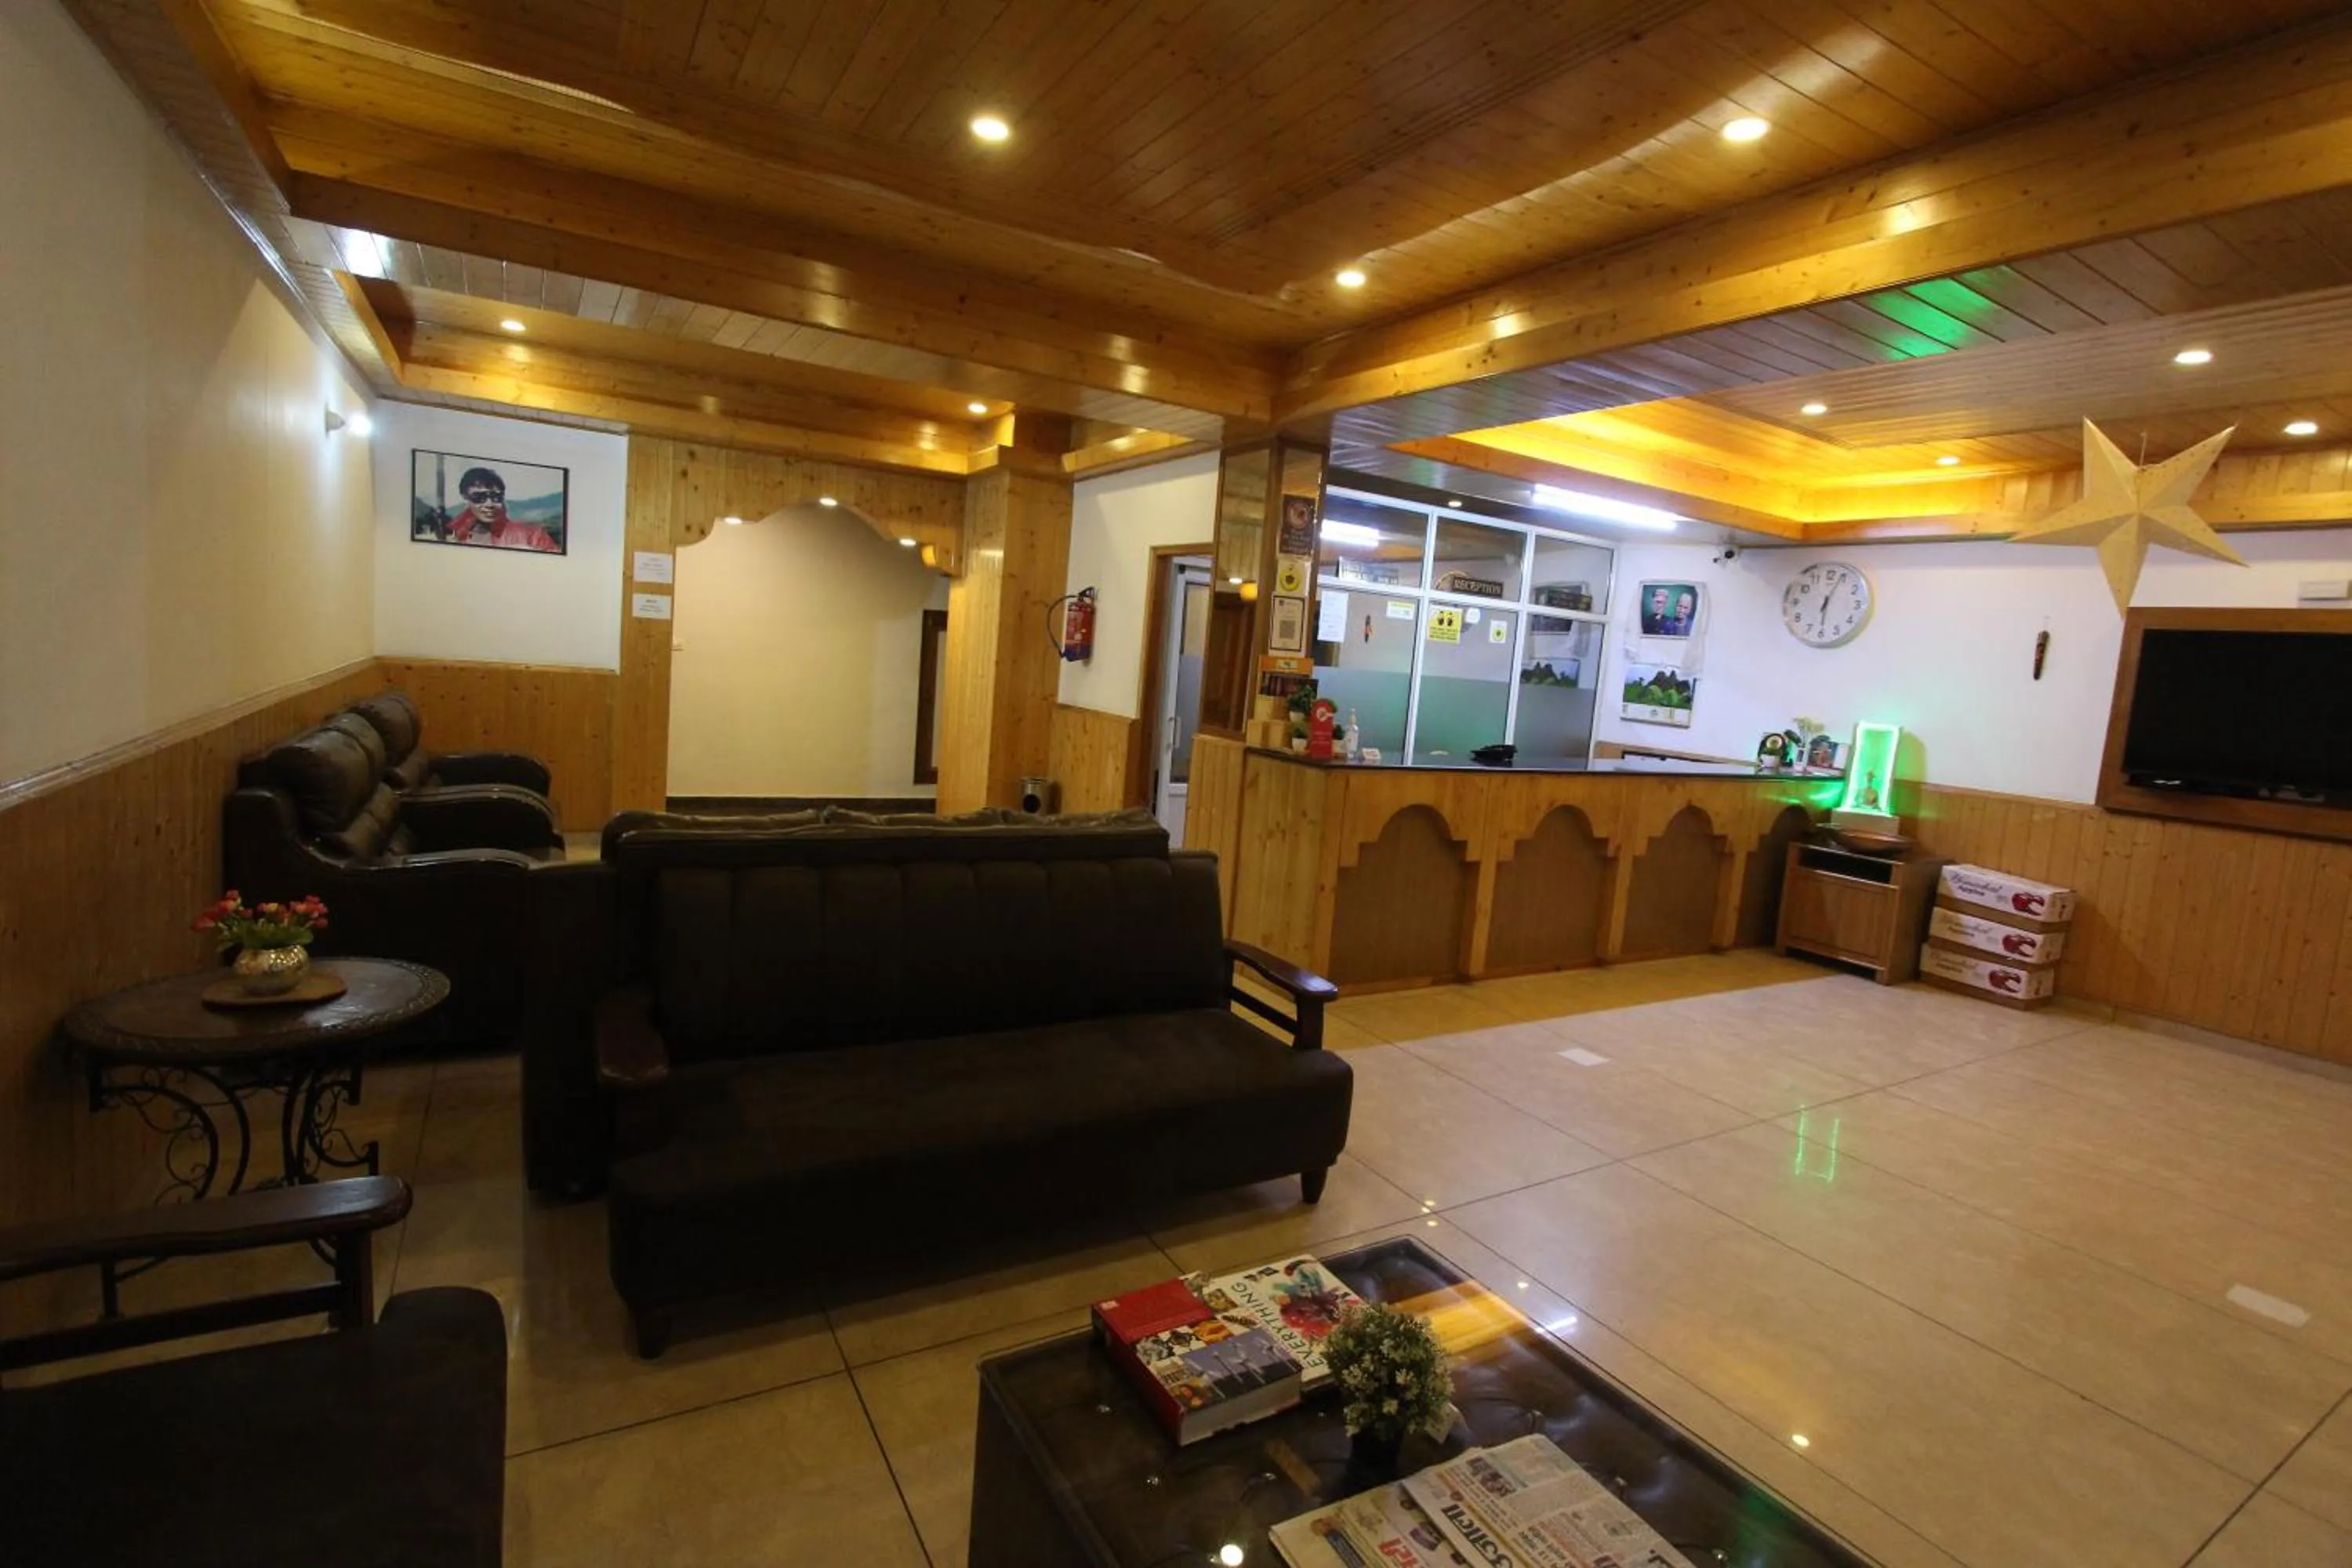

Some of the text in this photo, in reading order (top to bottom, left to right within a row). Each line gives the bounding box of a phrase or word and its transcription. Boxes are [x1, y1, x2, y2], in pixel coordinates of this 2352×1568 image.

[1454, 579, 1501, 594] RECEPTION
[1850, 584, 1858, 595] 2
[1853, 600, 1861, 610] 3
[1795, 612, 1802, 623] 8
[1846, 615, 1853, 624] 4
[1806, 623, 1813, 634] 7
[1817, 628, 1825, 639] 6
[1832, 625, 1840, 636] 5
[1231, 1283, 1324, 1367] EVERYTHING
